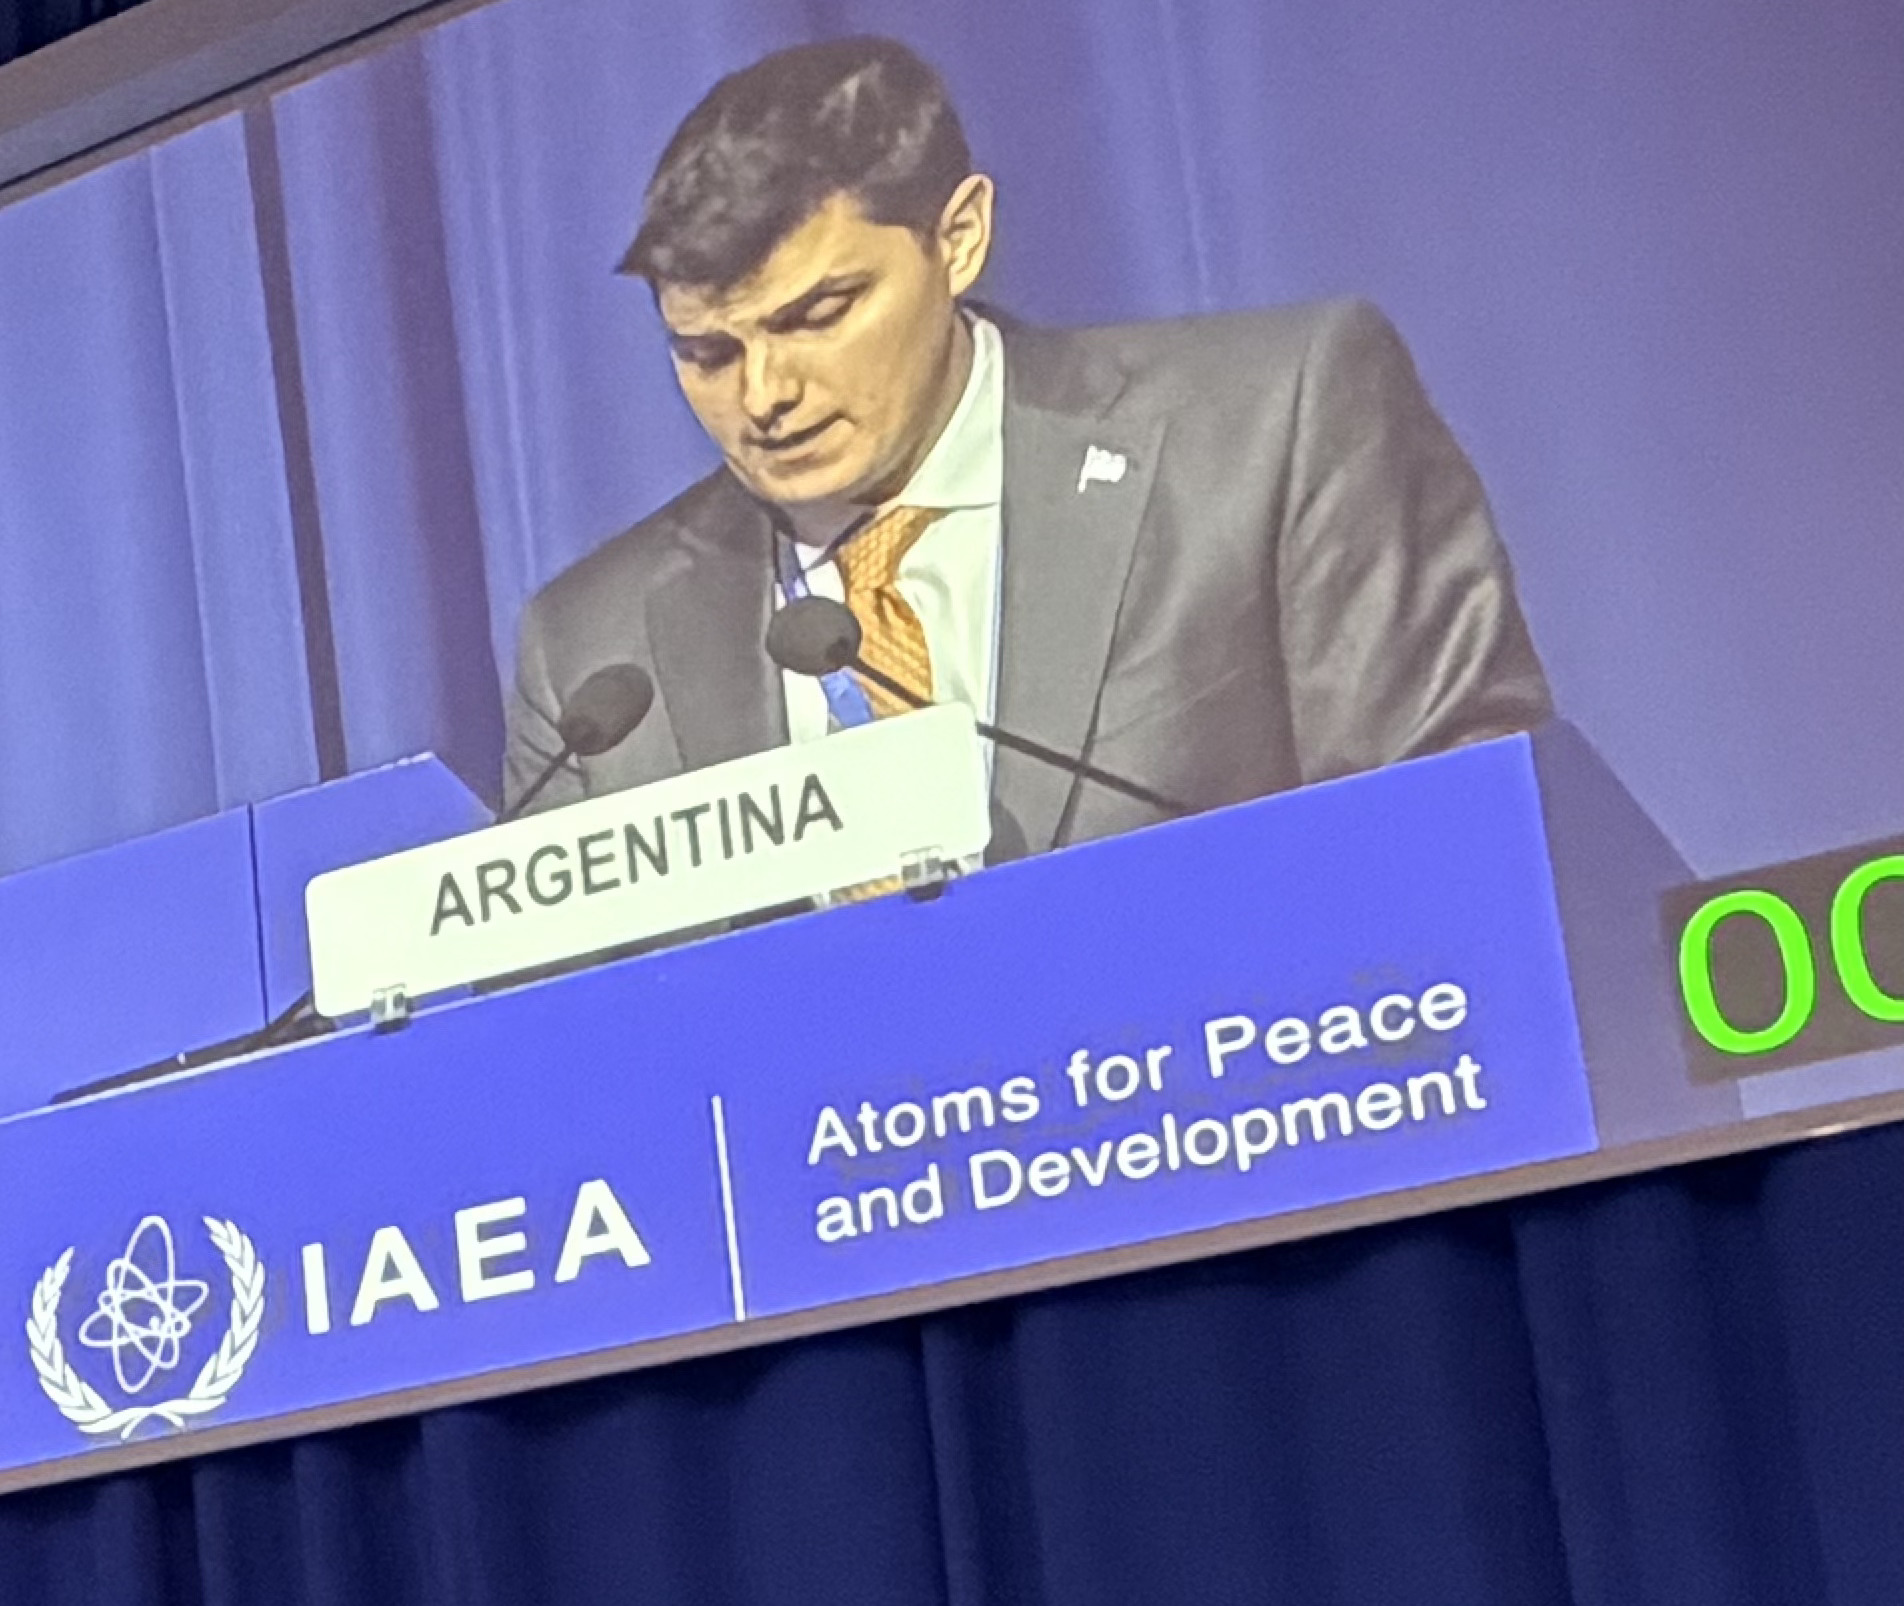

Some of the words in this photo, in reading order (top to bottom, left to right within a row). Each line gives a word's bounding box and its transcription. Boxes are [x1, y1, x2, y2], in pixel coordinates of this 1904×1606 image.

[428, 774, 845, 938] ARGENTINA
[807, 1073, 1040, 1164] Atoms
[1066, 1048, 1173, 1106] for
[1204, 981, 1469, 1078] Peace
[815, 1164, 944, 1243] and
[968, 1054, 1488, 1210] Development
[299, 1178, 651, 1337] IAEA
